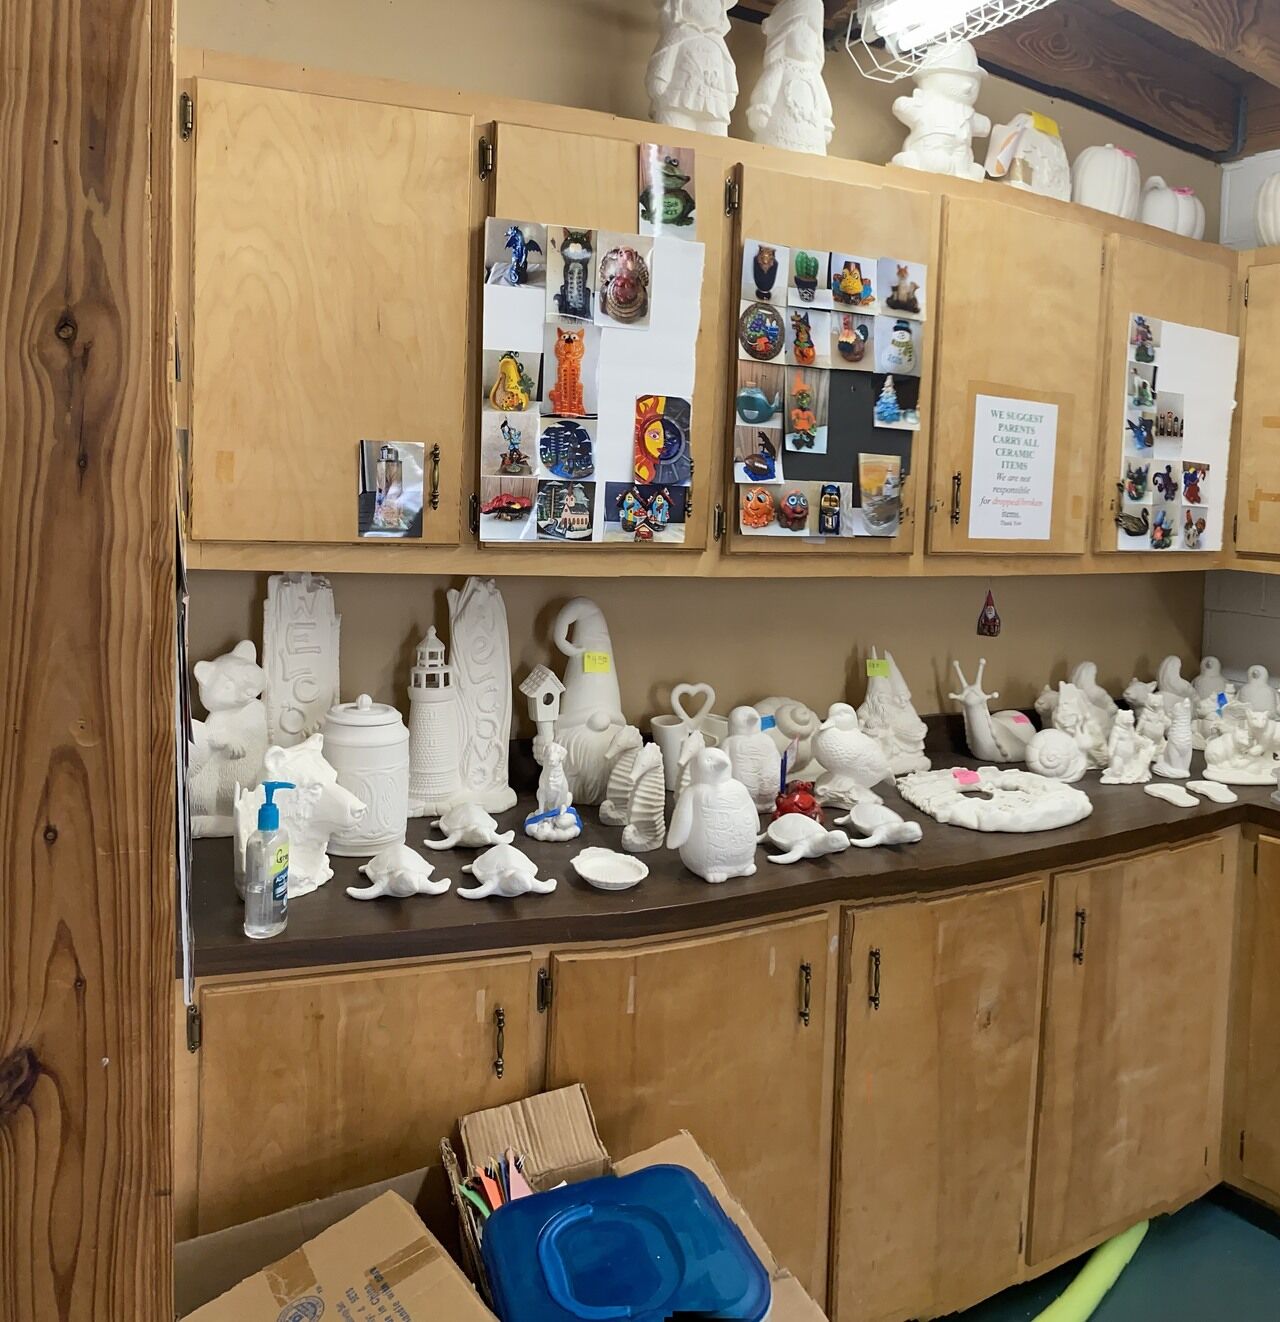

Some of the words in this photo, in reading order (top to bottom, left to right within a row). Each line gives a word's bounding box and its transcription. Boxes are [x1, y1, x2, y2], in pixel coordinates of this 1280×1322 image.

[991, 409, 1004, 419] WE
[1006, 412, 1044, 423] SUGGEST
[998, 423, 1036, 435] PARENTS
[992, 435, 1022, 446] CARRY
[1023, 438, 1040, 448] ALL
[995, 448, 1034, 459] CERAMIC
[1001, 460, 1028, 470] ITEMS
[996, 472, 1006, 482] We
[992, 486, 1031, 496] responsible
[980, 496, 991, 506] for
[364, 1284, 380, 1305] China
